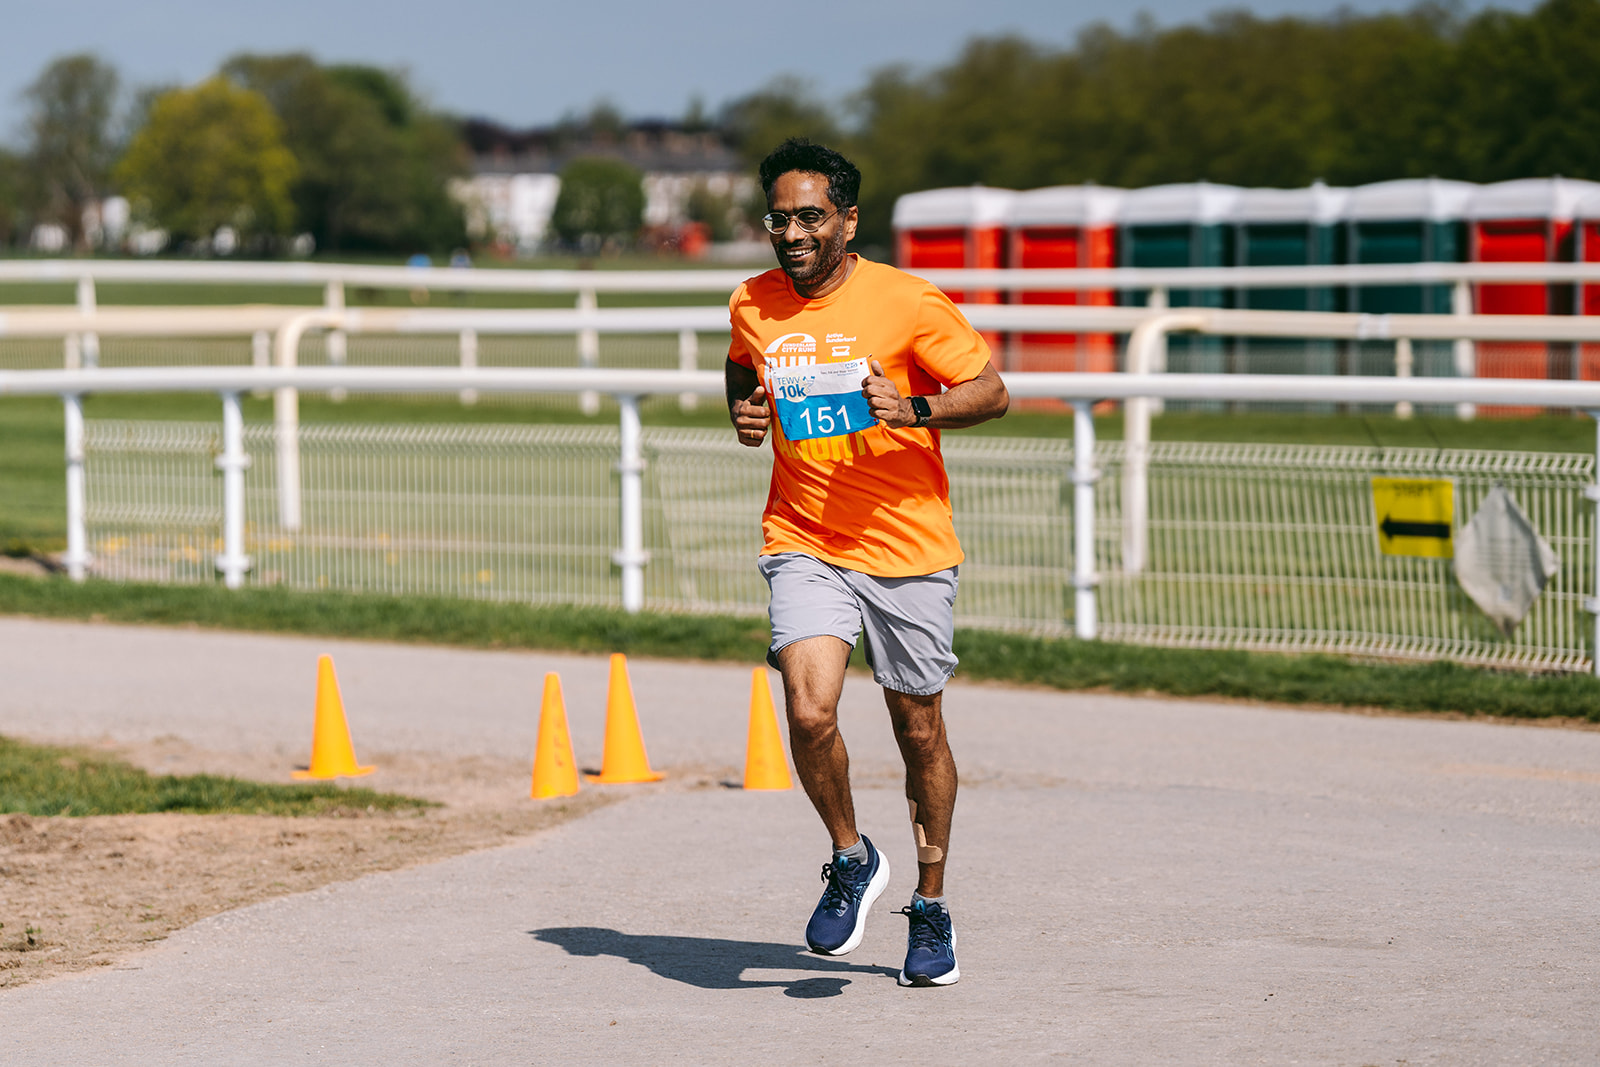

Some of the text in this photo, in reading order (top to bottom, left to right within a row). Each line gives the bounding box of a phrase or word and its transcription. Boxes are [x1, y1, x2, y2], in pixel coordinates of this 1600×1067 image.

[777, 376, 801, 385] TEWV
[779, 384, 807, 399] 10k
[799, 404, 851, 435] 151
